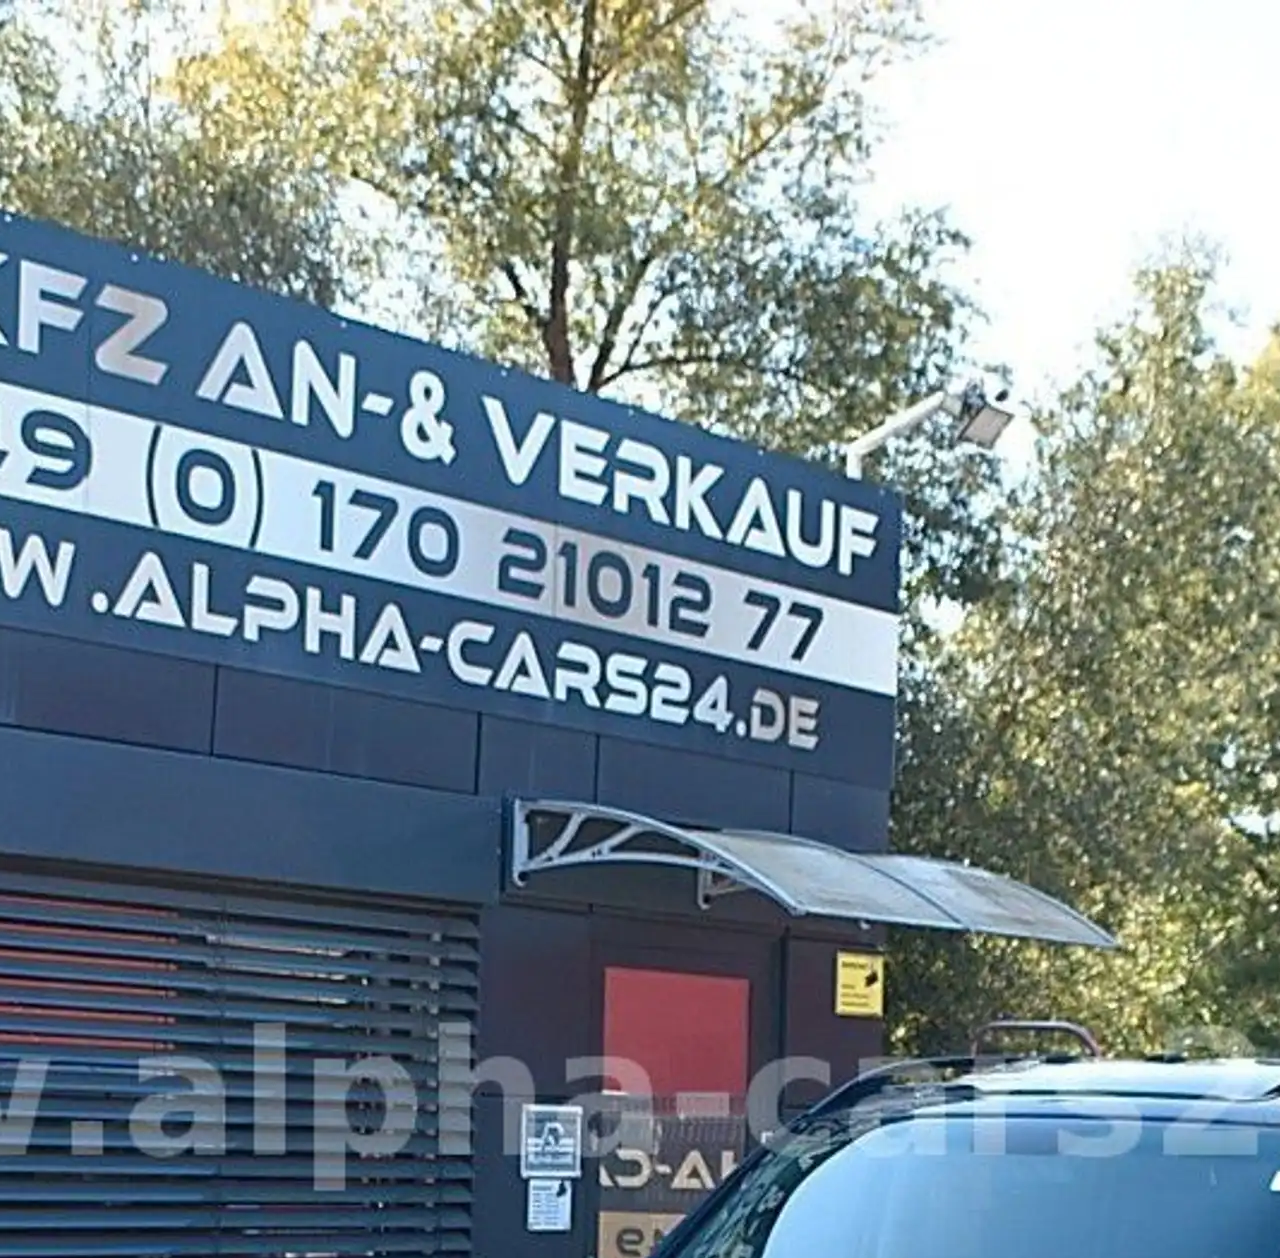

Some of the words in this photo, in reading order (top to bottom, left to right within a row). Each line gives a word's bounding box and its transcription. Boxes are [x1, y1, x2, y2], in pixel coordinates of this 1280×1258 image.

[146, 425, 264, 548] (0)
[312, 480, 460, 577] 170
[497, 526, 713, 639] 21012
[741, 588, 825, 661] 77
[482, 396, 880, 576] VERKAUF
